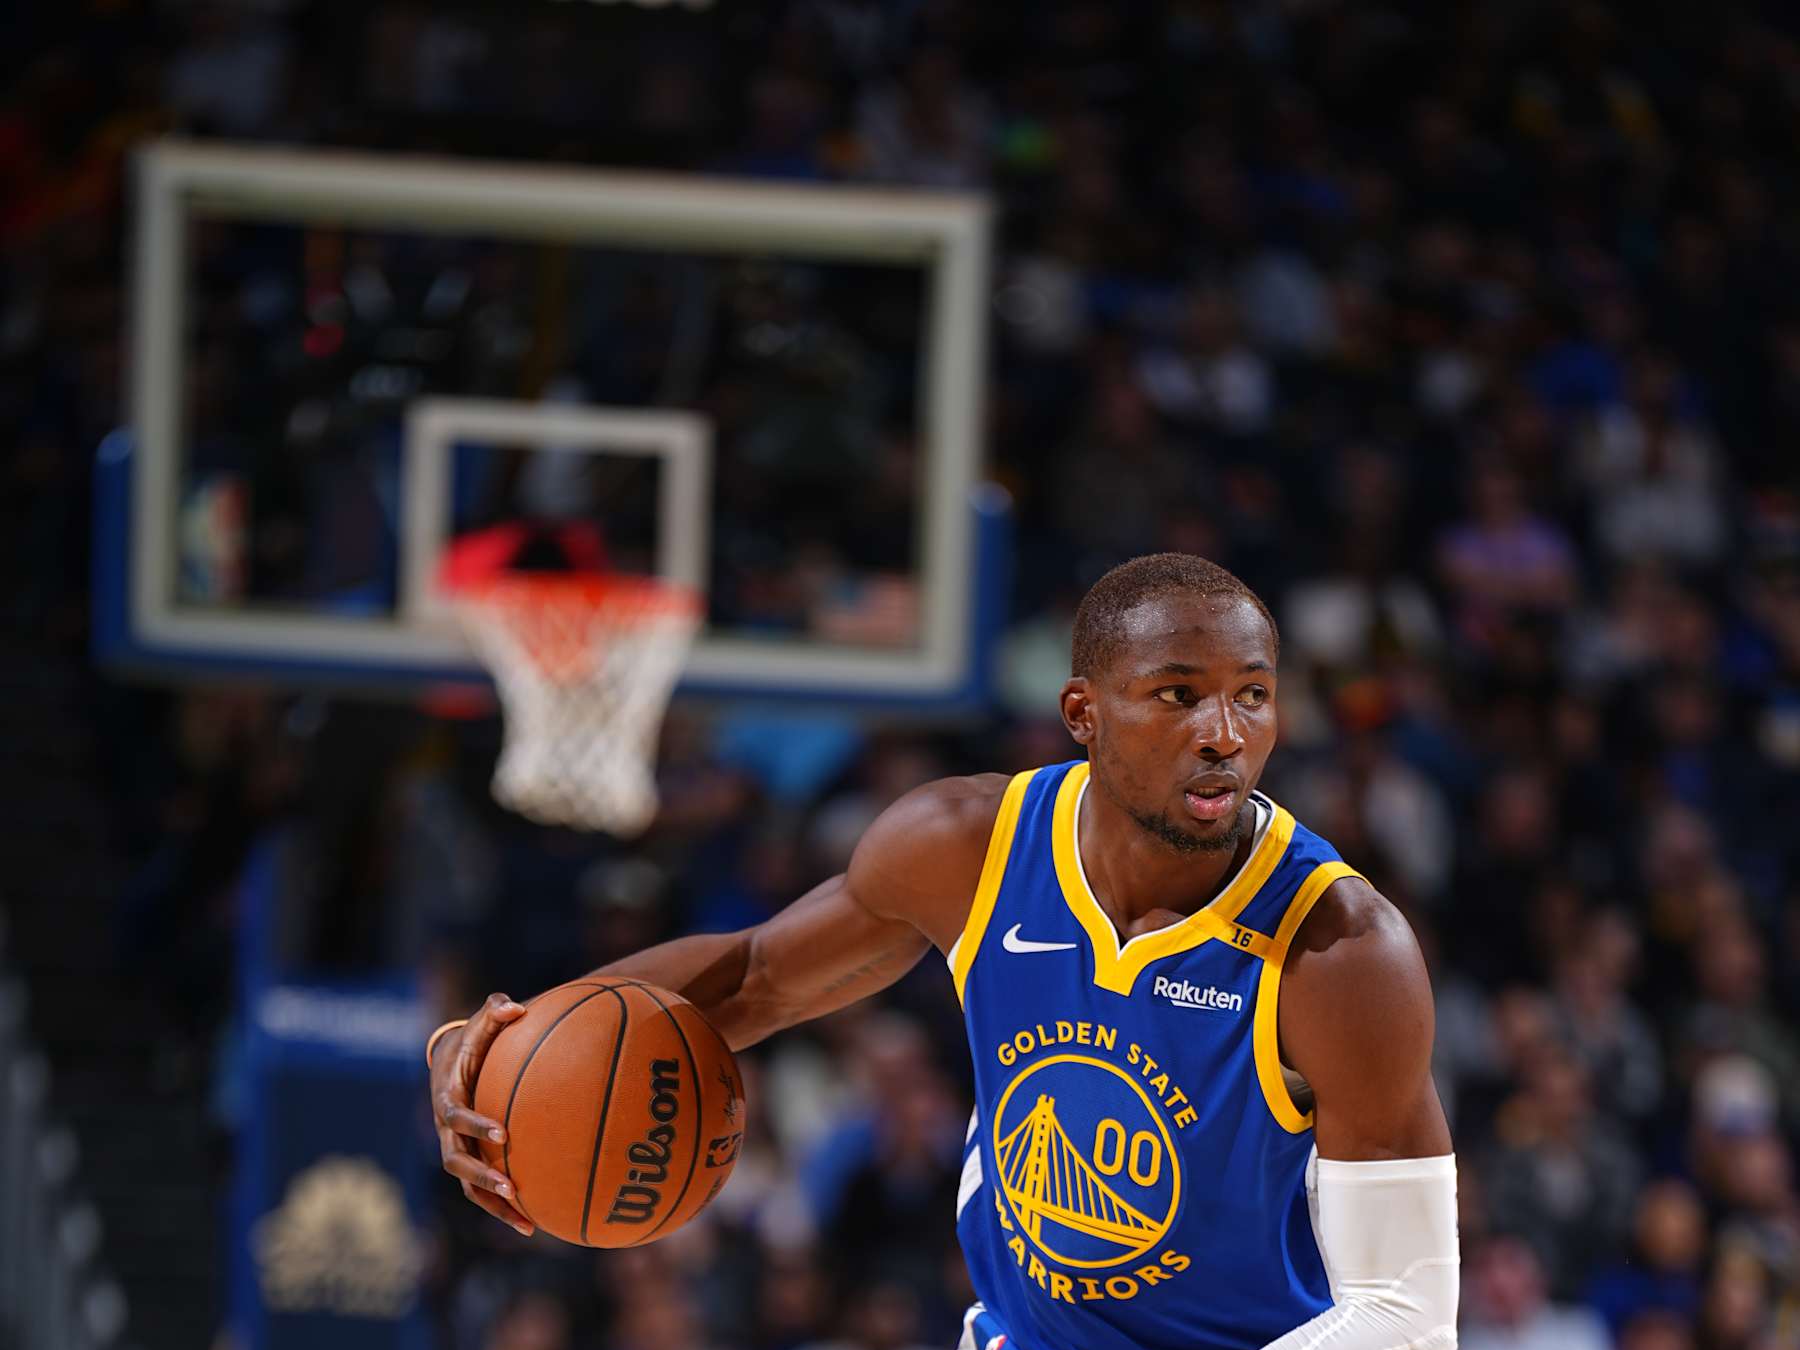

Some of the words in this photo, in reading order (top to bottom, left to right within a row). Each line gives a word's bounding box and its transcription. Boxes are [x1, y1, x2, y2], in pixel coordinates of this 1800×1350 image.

[1232, 927, 1253, 947] 16
[1153, 976, 1243, 1012] Rakuten
[997, 1020, 1118, 1067] GOLDEN
[1127, 1043, 1199, 1130] STATE
[604, 1057, 681, 1225] Wilson
[1093, 1118, 1162, 1188] 00
[995, 1185, 1192, 1304] WARRIORS
